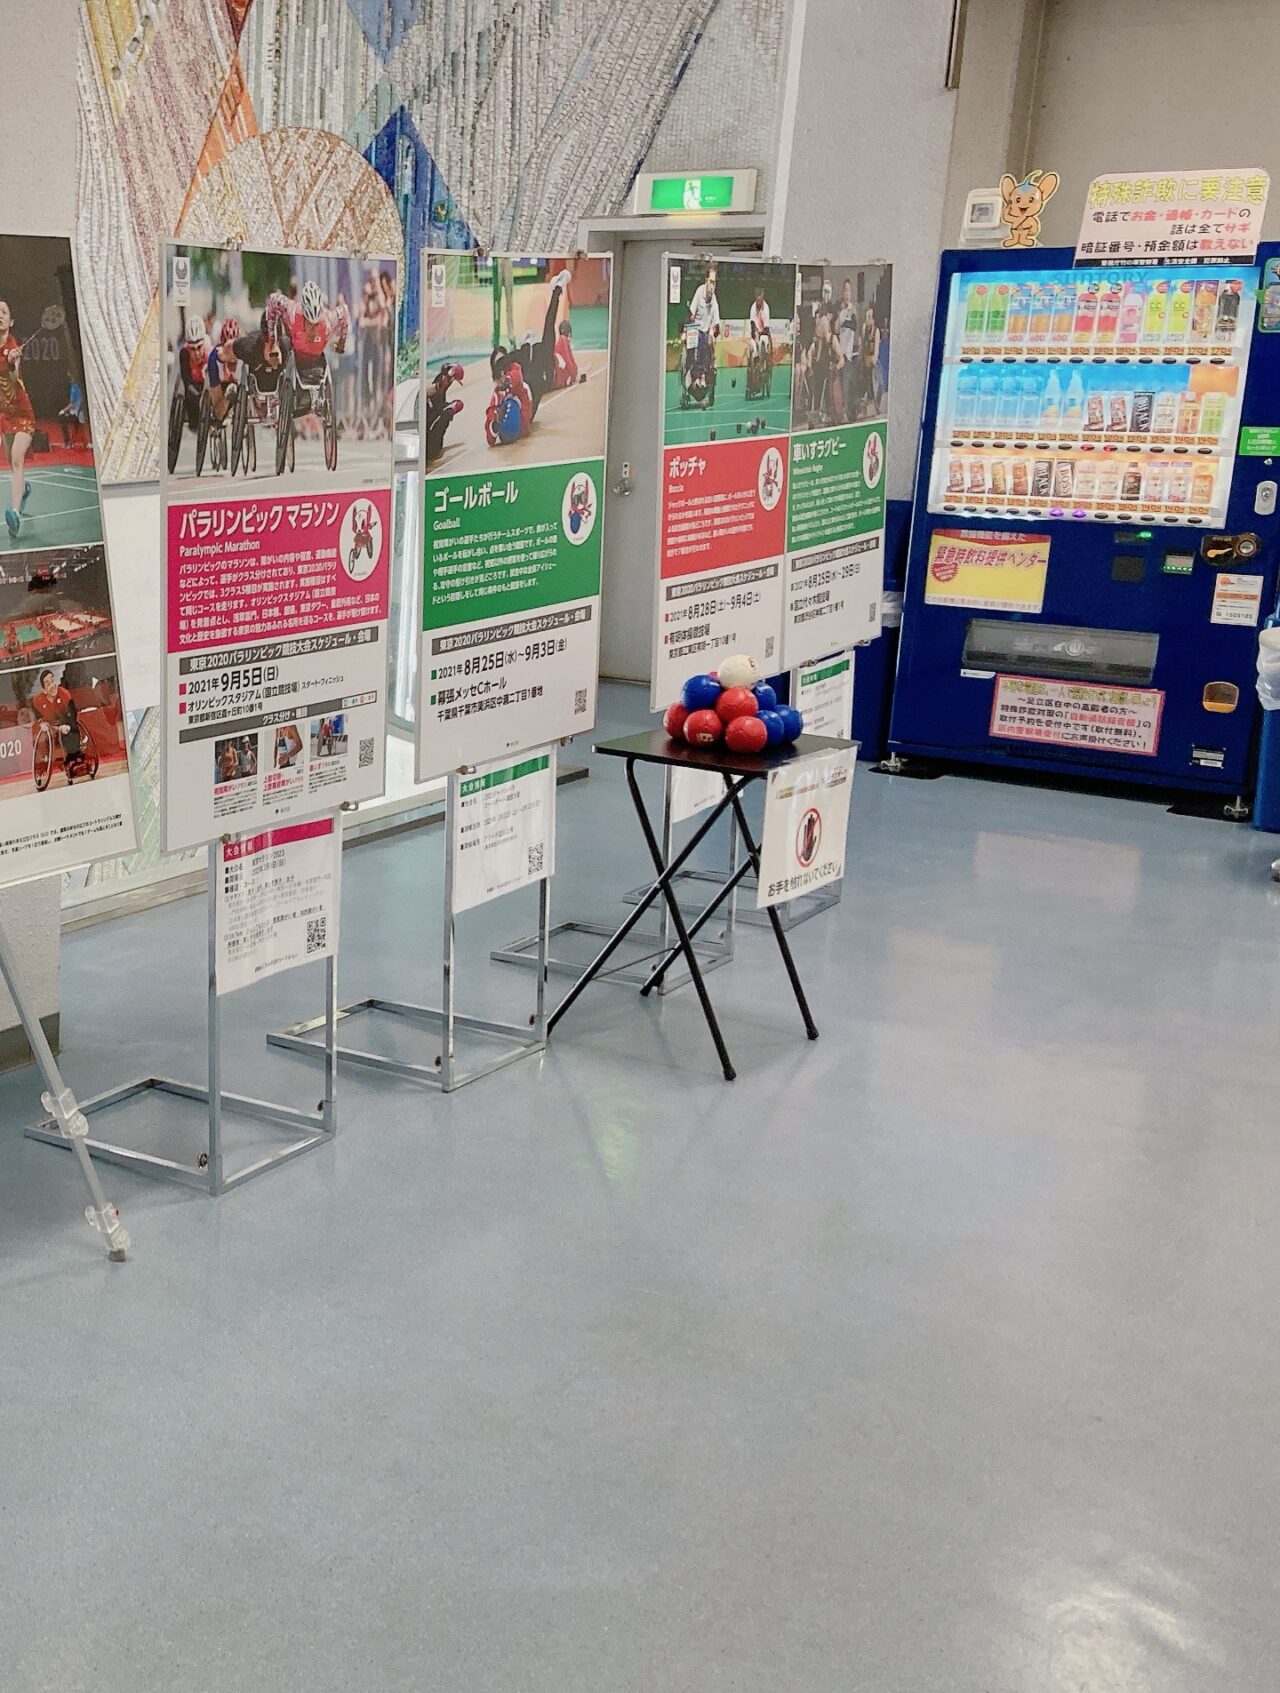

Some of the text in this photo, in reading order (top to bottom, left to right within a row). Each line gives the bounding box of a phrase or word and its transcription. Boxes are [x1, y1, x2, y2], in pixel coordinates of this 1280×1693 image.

[1089, 175, 1268, 209] 特殊詐欺に要注意
[1170, 222, 1250, 236] 話は全てサギ
[792, 436, 847, 463] 車いすラグビー
[434, 480, 519, 513] ゴールボール
[433, 518, 461, 532] Goalball
[179, 539, 260, 557] Paralympic Marathon
[437, 676, 507, 706] 幕張メッセCホール
[767, 862, 837, 897] お手を触れないでください
